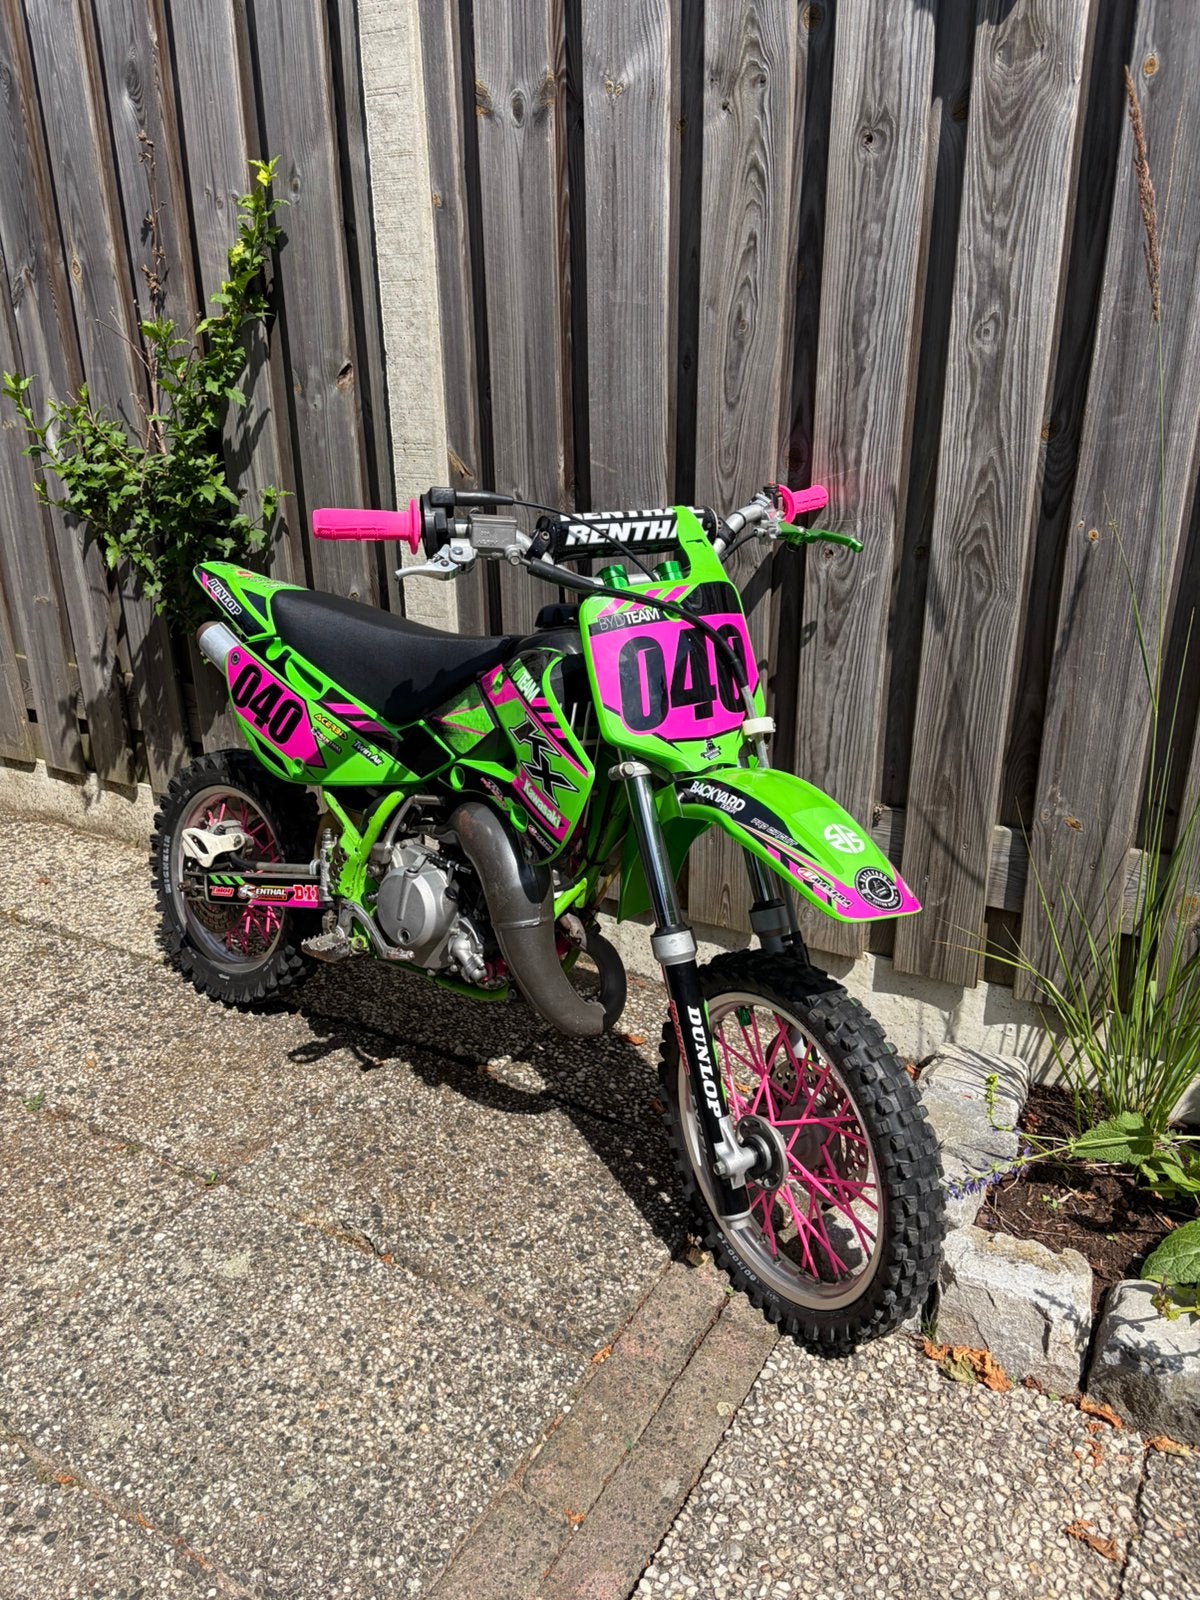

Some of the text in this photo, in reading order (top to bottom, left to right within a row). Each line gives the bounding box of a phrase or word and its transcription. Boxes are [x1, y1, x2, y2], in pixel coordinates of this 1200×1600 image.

[565, 519, 709, 546] RENTH
[207, 578, 242, 615] DUNLOP
[231, 663, 303, 745] 040
[618, 623, 747, 732] 040
[353, 740, 383, 766] Twin Air
[509, 713, 580, 808] KX
[523, 779, 561, 829] Kawasaki
[690, 780, 746, 812] BACKYARD
[163, 834, 172, 894] MICHELIN
[687, 1005, 722, 1118] DUNLOP
